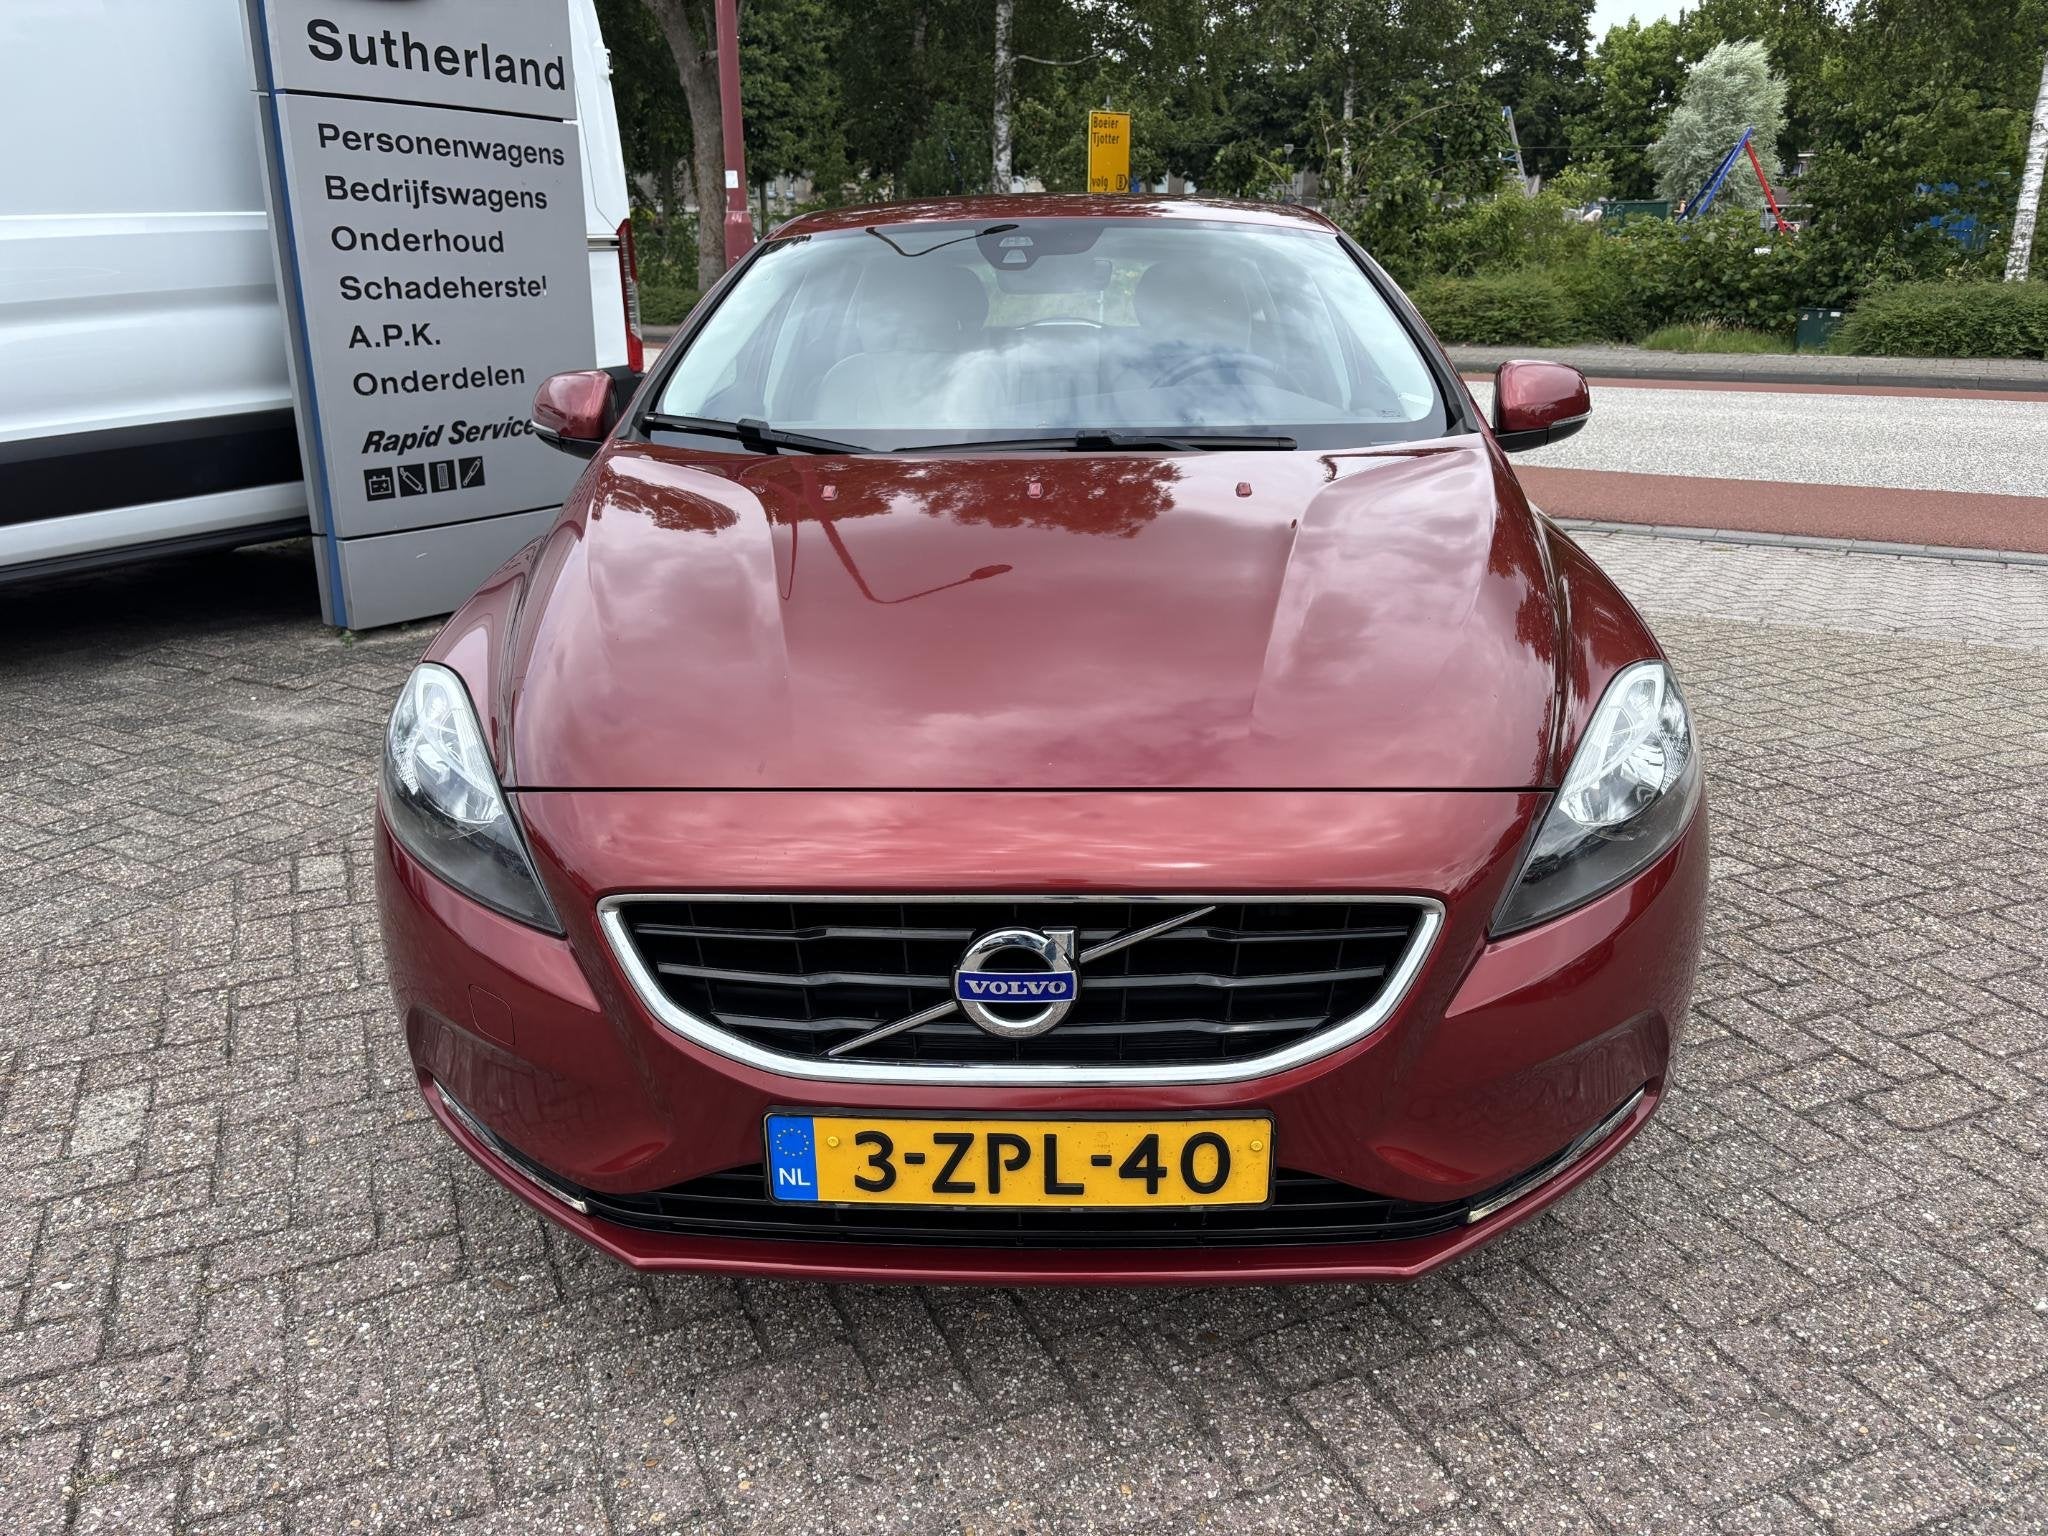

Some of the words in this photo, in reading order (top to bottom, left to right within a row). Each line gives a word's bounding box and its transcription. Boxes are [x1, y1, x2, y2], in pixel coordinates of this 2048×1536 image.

[307, 18, 566, 91] Sutherland
[1093, 117, 1119, 129] Boeier
[318, 122, 565, 168] Personenwagens
[1092, 132, 1120, 147] Tjotter
[325, 175, 547, 213] Bedrijfswagens
[1091, 176, 1109, 190] volg
[331, 225, 504, 253] Onderhoud
[348, 323, 441, 349] A.P.K.
[353, 365, 525, 396] Onderdelen
[361, 425, 445, 456] Rapid
[448, 416, 535, 445] Service
[964, 979, 1067, 995] VOLVO
[779, 1167, 811, 1186] NL
[853, 1130, 1232, 1195] 3-ZPL-40
